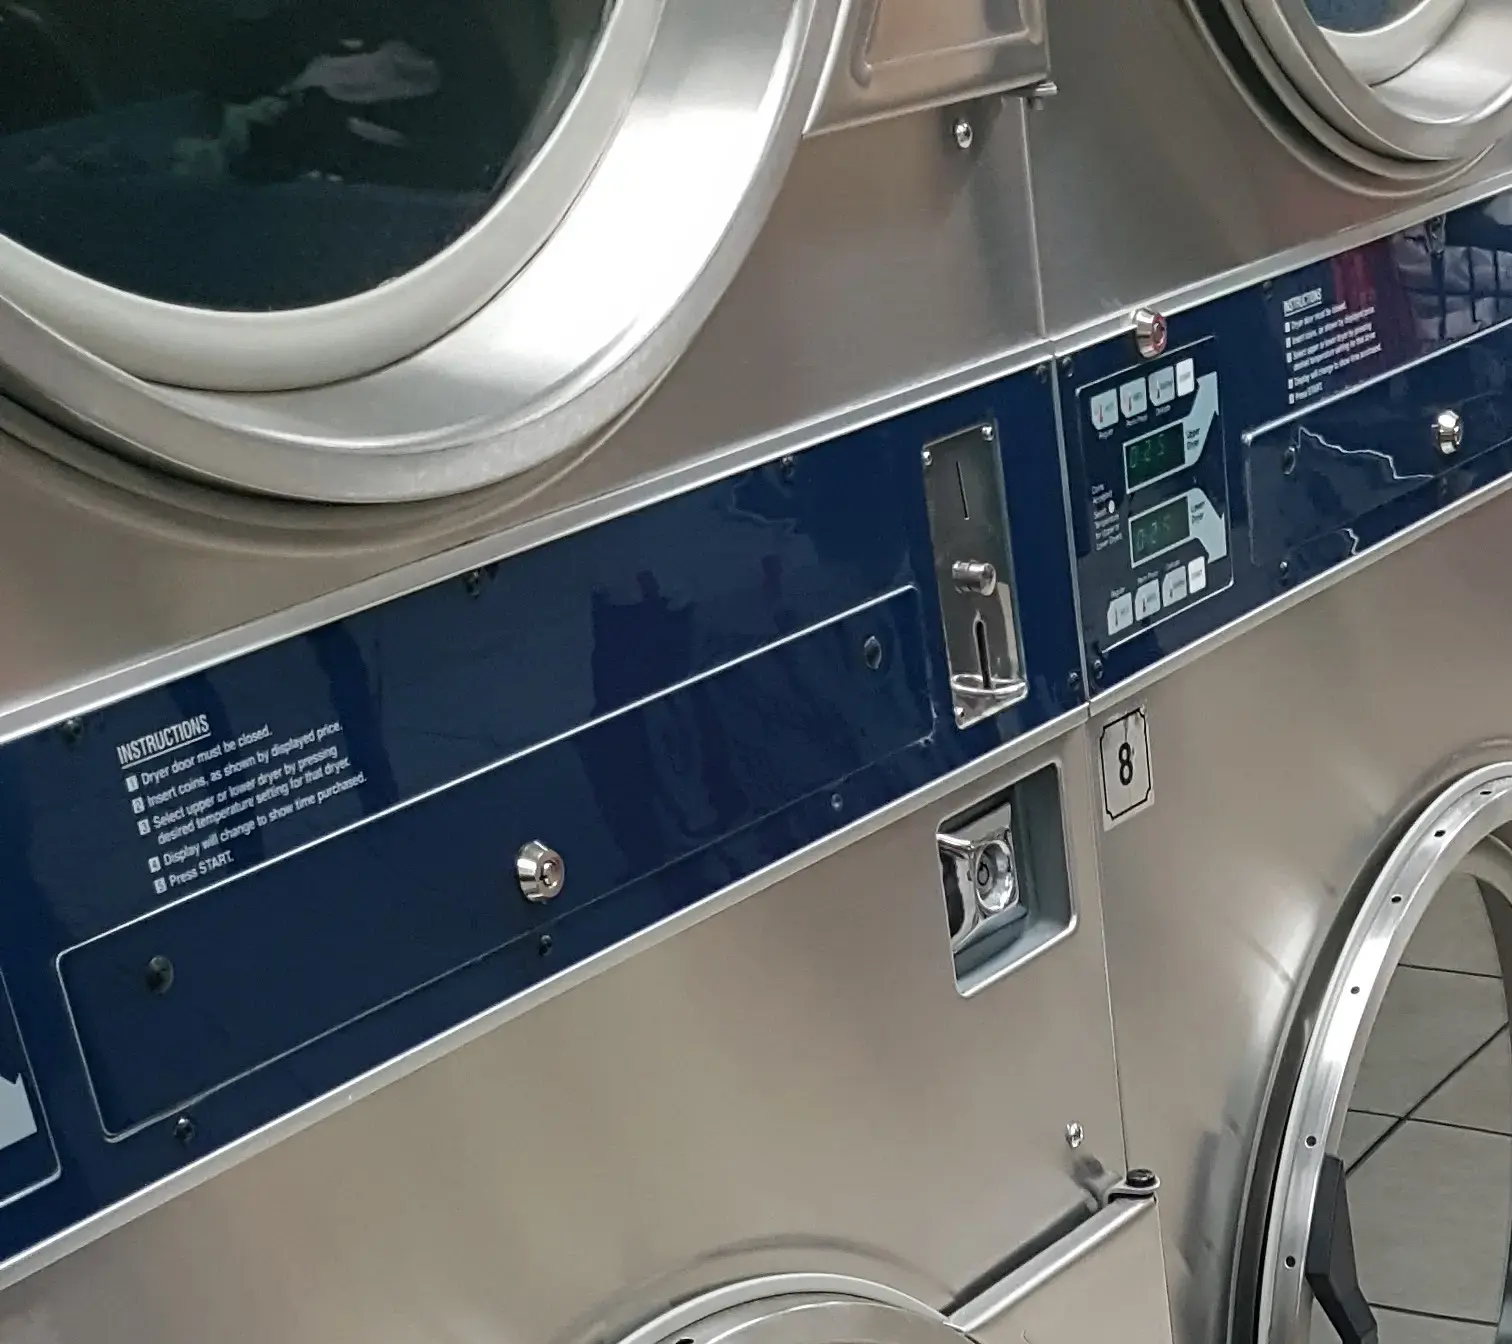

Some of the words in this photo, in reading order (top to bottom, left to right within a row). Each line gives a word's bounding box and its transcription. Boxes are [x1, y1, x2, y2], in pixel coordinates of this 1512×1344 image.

[116, 714, 210, 764] INSTRUCTIONS
[141, 766, 170, 784] Dryer
[171, 756, 195, 774] door
[197, 744, 222, 763] must
[222, 739, 236, 752] be
[238, 723, 273, 747] closed.
[147, 786, 177, 808] Insert
[178, 775, 209, 794] coins,
[210, 769, 222, 782] as
[224, 756, 256, 777] shown
[256, 750, 269, 764] by
[271, 729, 315, 757] displayed
[316, 721, 343, 742] price.
[1119, 742, 1133, 786] 8
[152, 807, 185, 829] Select
[186, 795, 215, 816] upper
[216, 790, 227, 802] or
[228, 779, 256, 797] lower
[257, 768, 283, 786] dryer
[284, 763, 296, 776] by
[298, 746, 338, 772] pressing
[157, 820, 195, 845] desired
[195, 797, 254, 829] temperature
[255, 783, 289, 804] setting
[289, 776, 304, 789] for
[304, 767, 323, 783] that
[324, 757, 351, 775] dryer.
[163, 843, 200, 866] Display
[201, 832, 219, 850] will
[220, 820, 256, 841] change
[256, 816, 268, 827] to
[268, 804, 294, 822] show
[294, 794, 316, 811] time
[317, 771, 367, 804] purchased.
[168, 868, 198, 887] Press
[198, 850, 234, 875] START.
